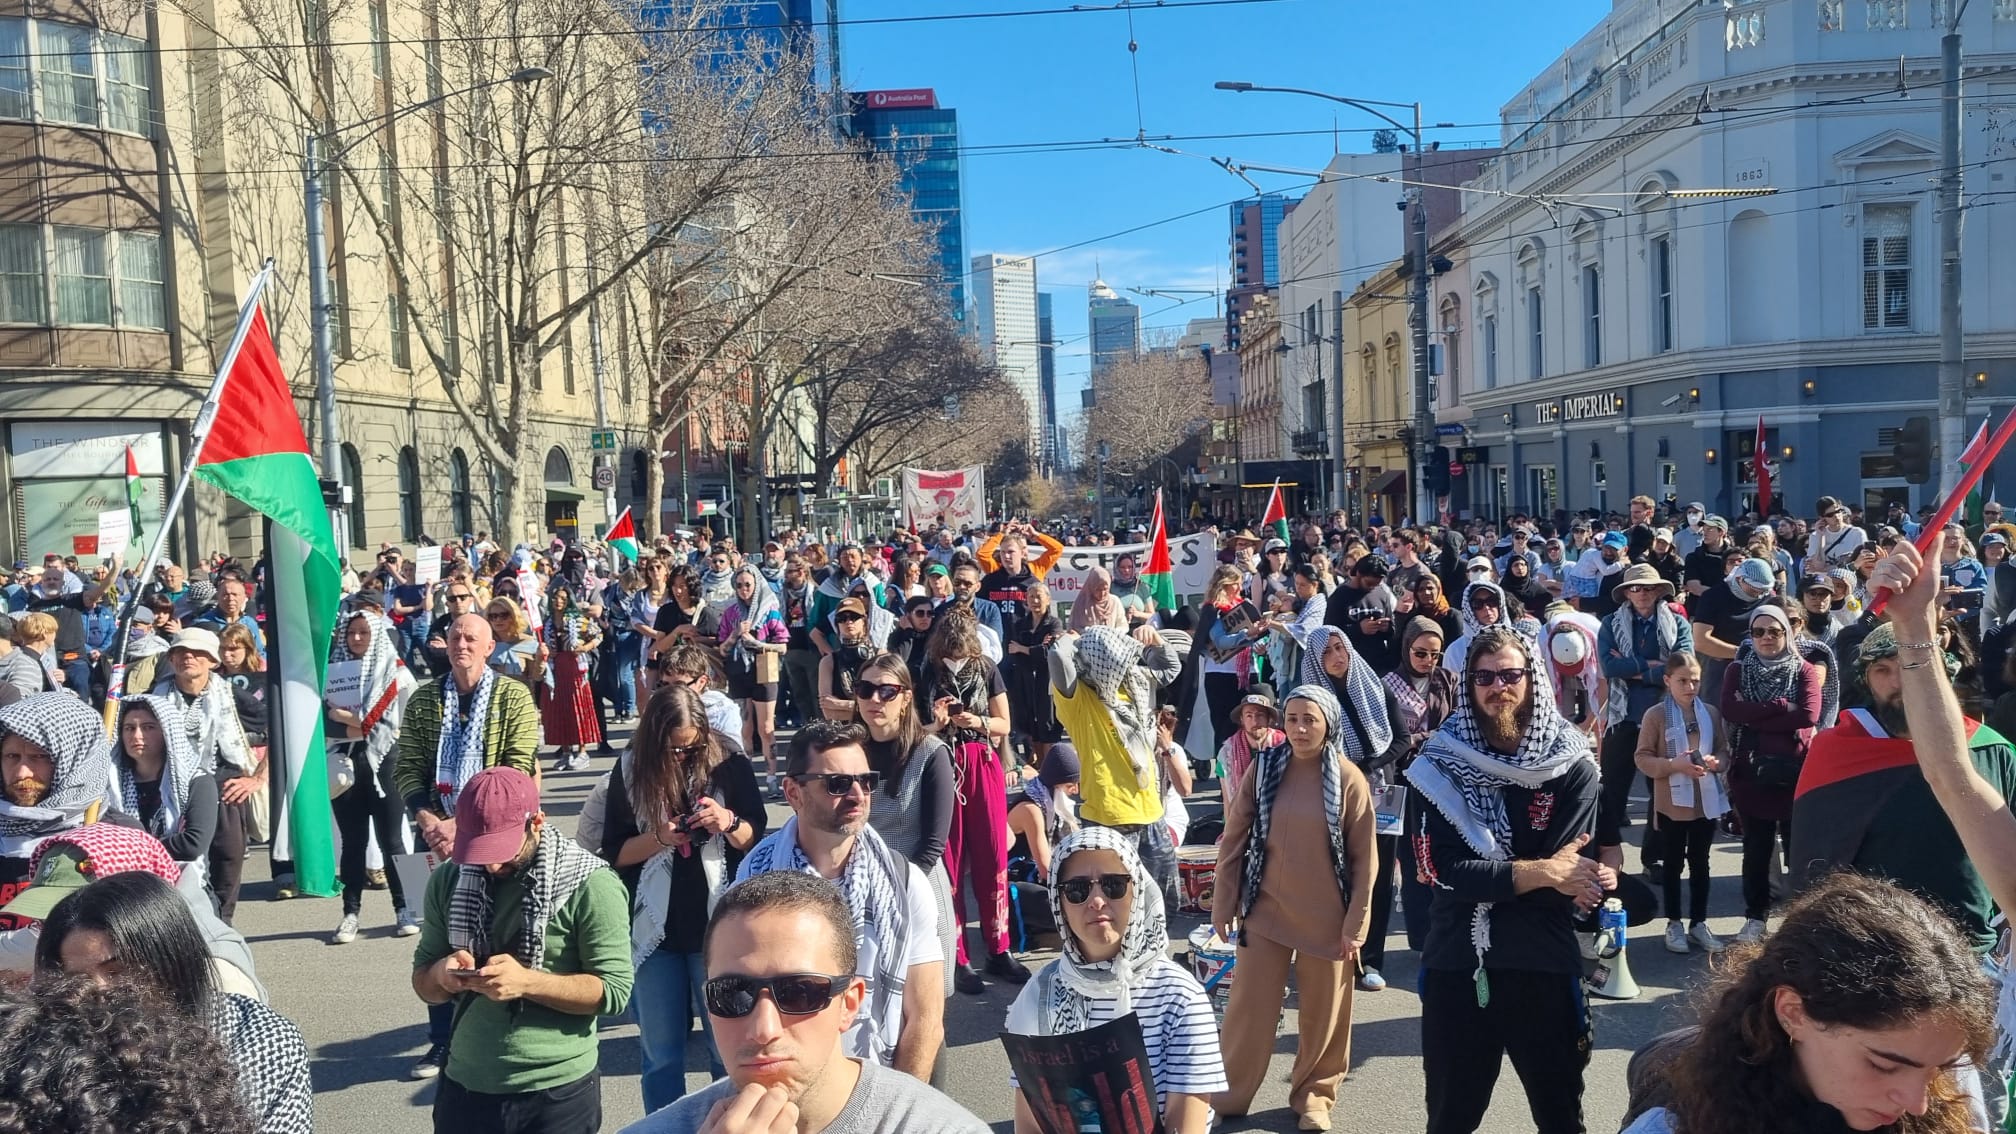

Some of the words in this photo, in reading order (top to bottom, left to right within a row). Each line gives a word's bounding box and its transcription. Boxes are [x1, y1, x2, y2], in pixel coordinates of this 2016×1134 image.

[1736, 169, 1763, 183] 1863
[1564, 392, 1618, 420] IMPERIAL
[31, 438, 64, 449] THE
[72, 437, 150, 449] WINDSOR
[599, 472, 611, 482] 40
[1001, 600, 1016, 614] 36
[329, 677, 345, 685] WE
[326, 684, 361, 694] SURREN
[1017, 1042, 1075, 1066] Israel
[1079, 1039, 1101, 1061] is
[1105, 1037, 1121, 1054] a
